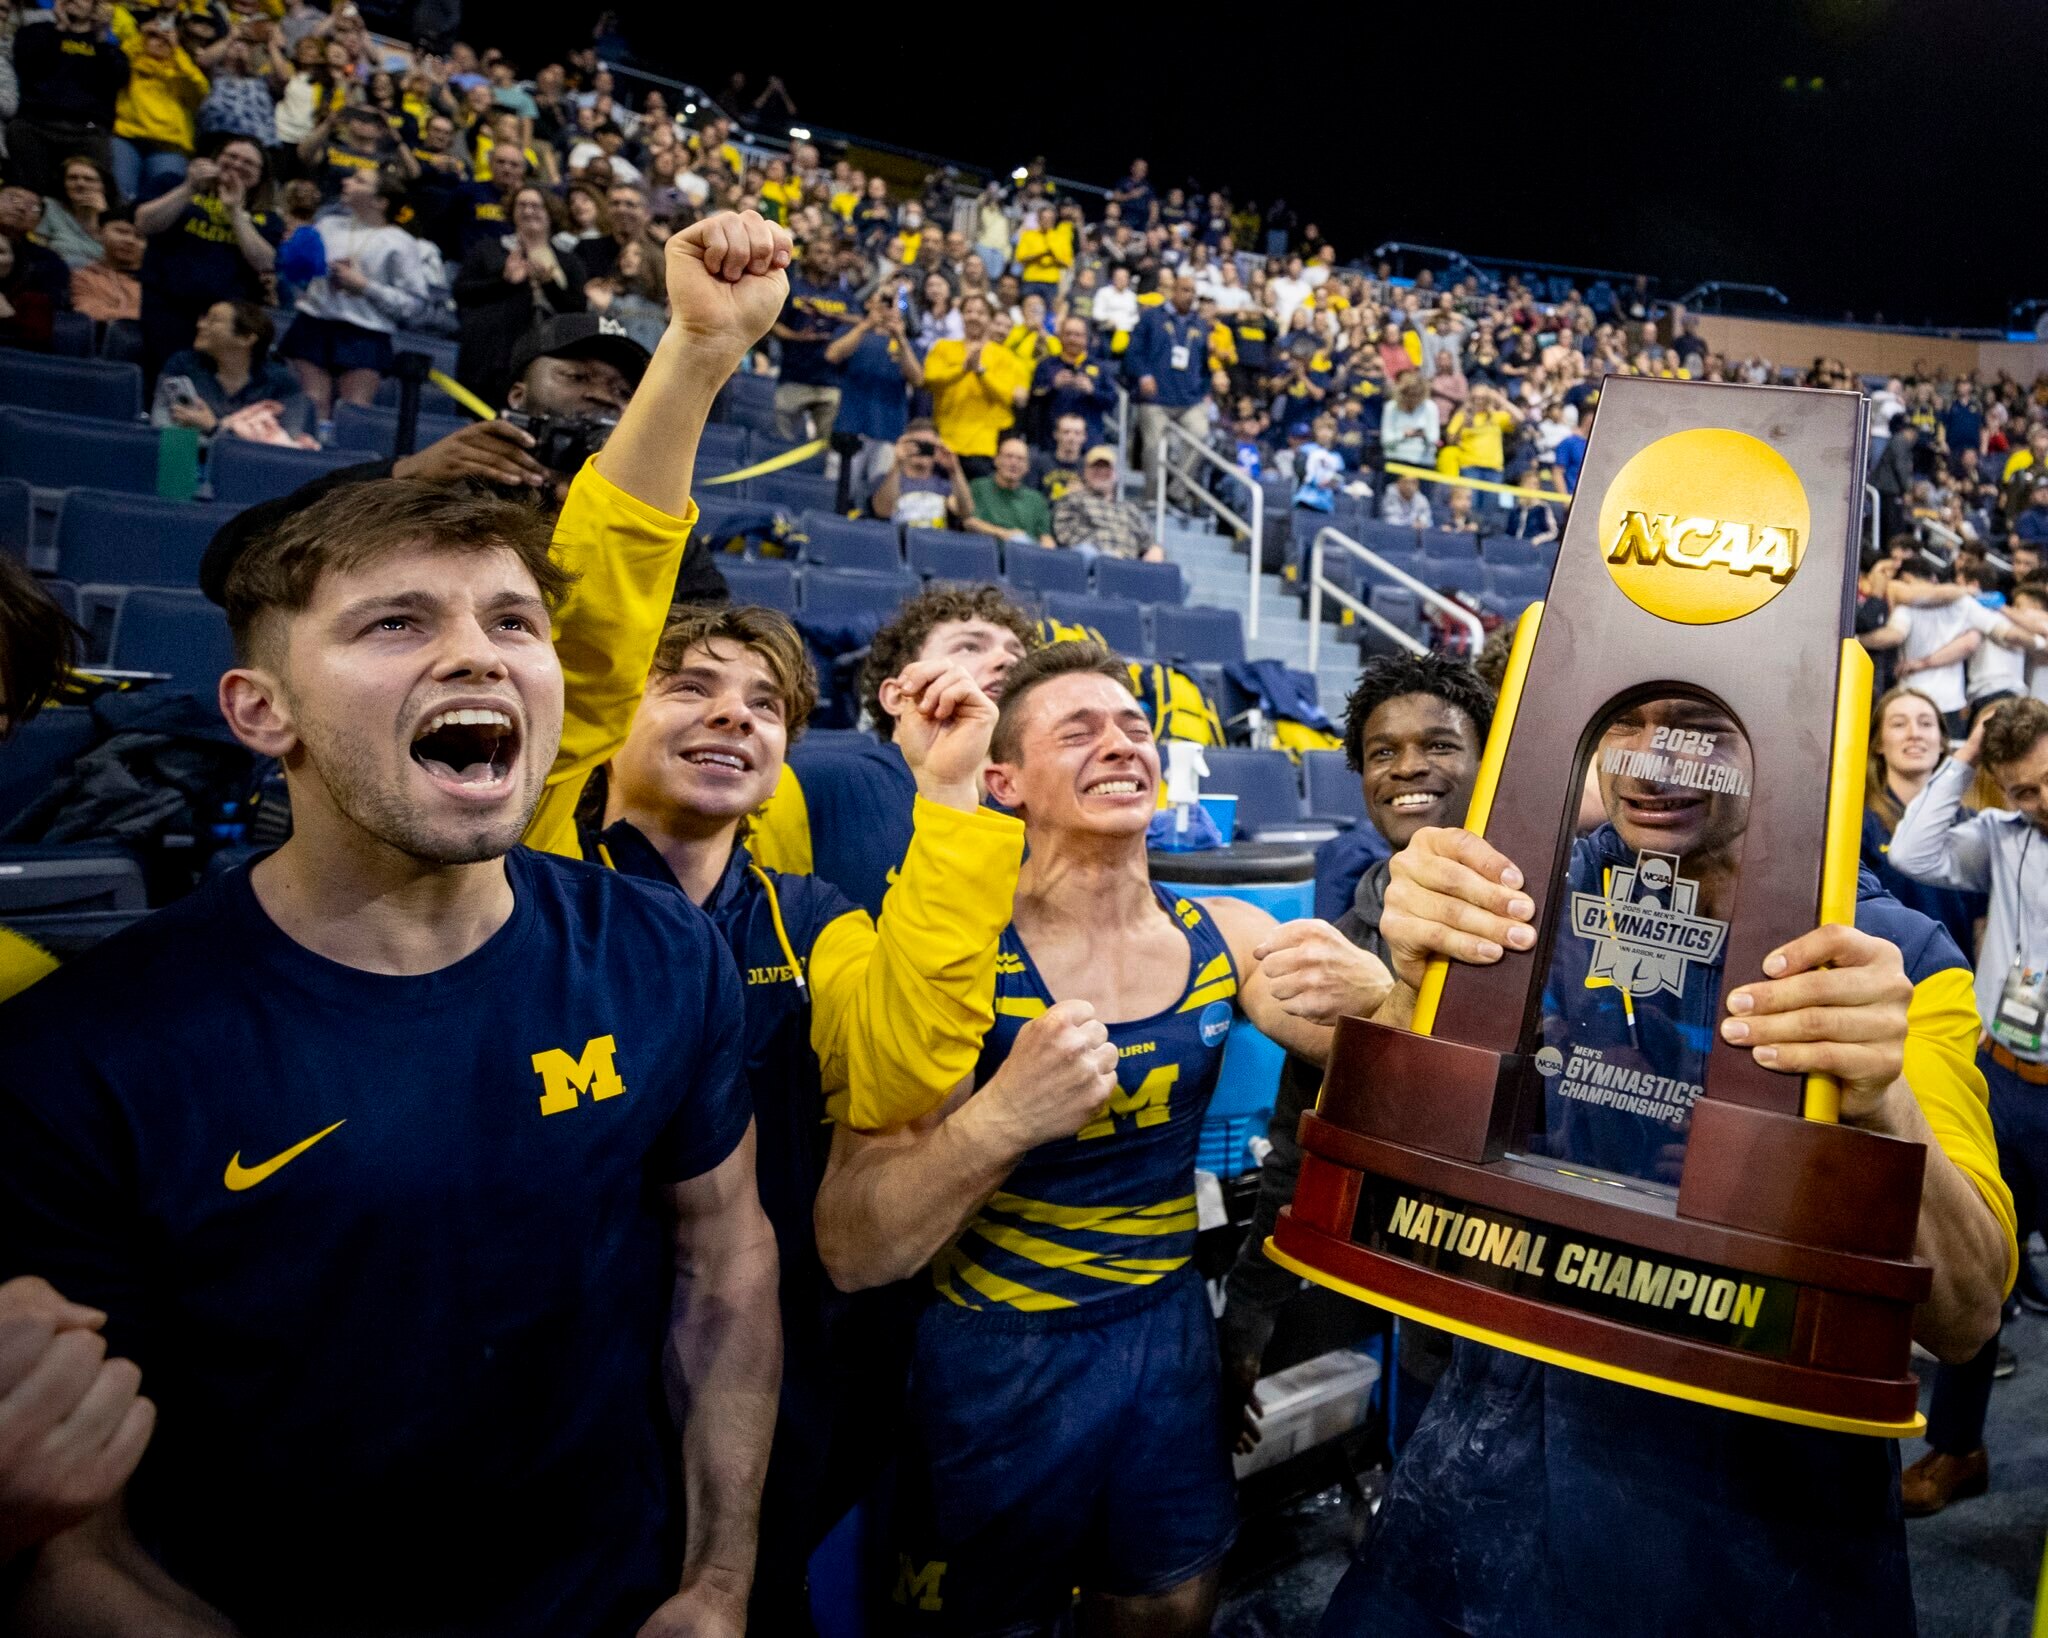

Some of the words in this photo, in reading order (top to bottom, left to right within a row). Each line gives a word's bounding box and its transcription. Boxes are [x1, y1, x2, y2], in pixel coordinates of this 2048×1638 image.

[1608, 511, 1798, 584] NCAA
[1650, 726, 1718, 757] 2025
[1601, 747, 1669, 782] NATIONAL
[1583, 907, 1713, 950] GYMNASTICS
[1622, 904, 1640, 913] 2025
[1642, 908, 1653, 916] NC
[1653, 911, 1676, 920] MEN'S
[531, 1034, 625, 1116] M
[1537, 1058, 1561, 1071] NCAA
[1573, 1045, 1603, 1060] MEN'S
[1078, 1064, 1179, 1141] M
[1558, 1079, 1686, 1124] CHAMPIONSHIPS
[1565, 1056, 1704, 1108] GYMNASTICS
[1388, 1196, 1545, 1277] NATIONAL
[1554, 1243, 1765, 1328] CHAMPION
[892, 1552, 948, 1611] M
